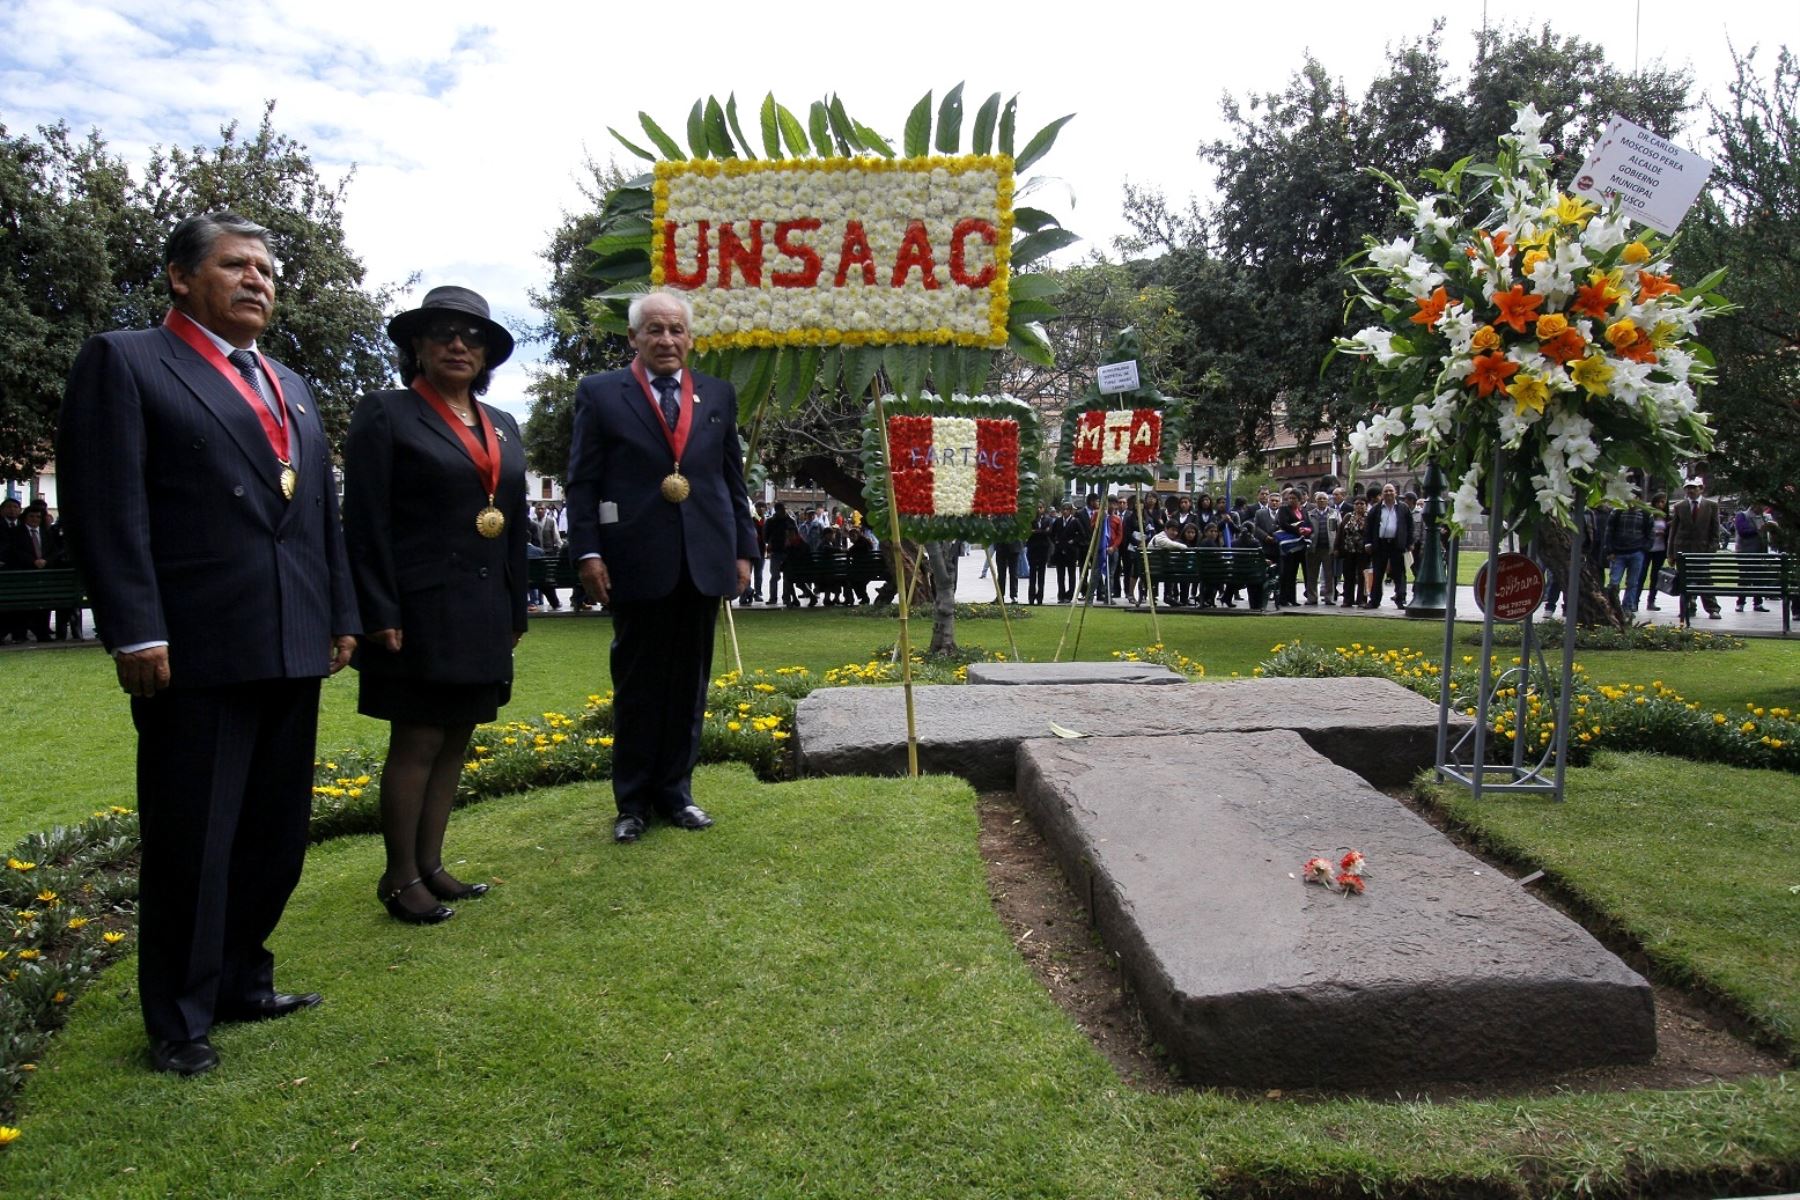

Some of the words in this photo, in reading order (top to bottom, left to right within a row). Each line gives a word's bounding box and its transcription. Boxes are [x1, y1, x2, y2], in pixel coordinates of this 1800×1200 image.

[1620, 137, 1660, 160] MOSCOSO
[1660, 155, 1683, 172] PEREA
[1628, 155, 1663, 175] ALCALDE
[1610, 174, 1653, 199] MUNICIPAL
[1618, 164, 1660, 187] GOBIERNO
[663, 218, 998, 290] UNSAAC
[1077, 421, 1151, 450] MTA
